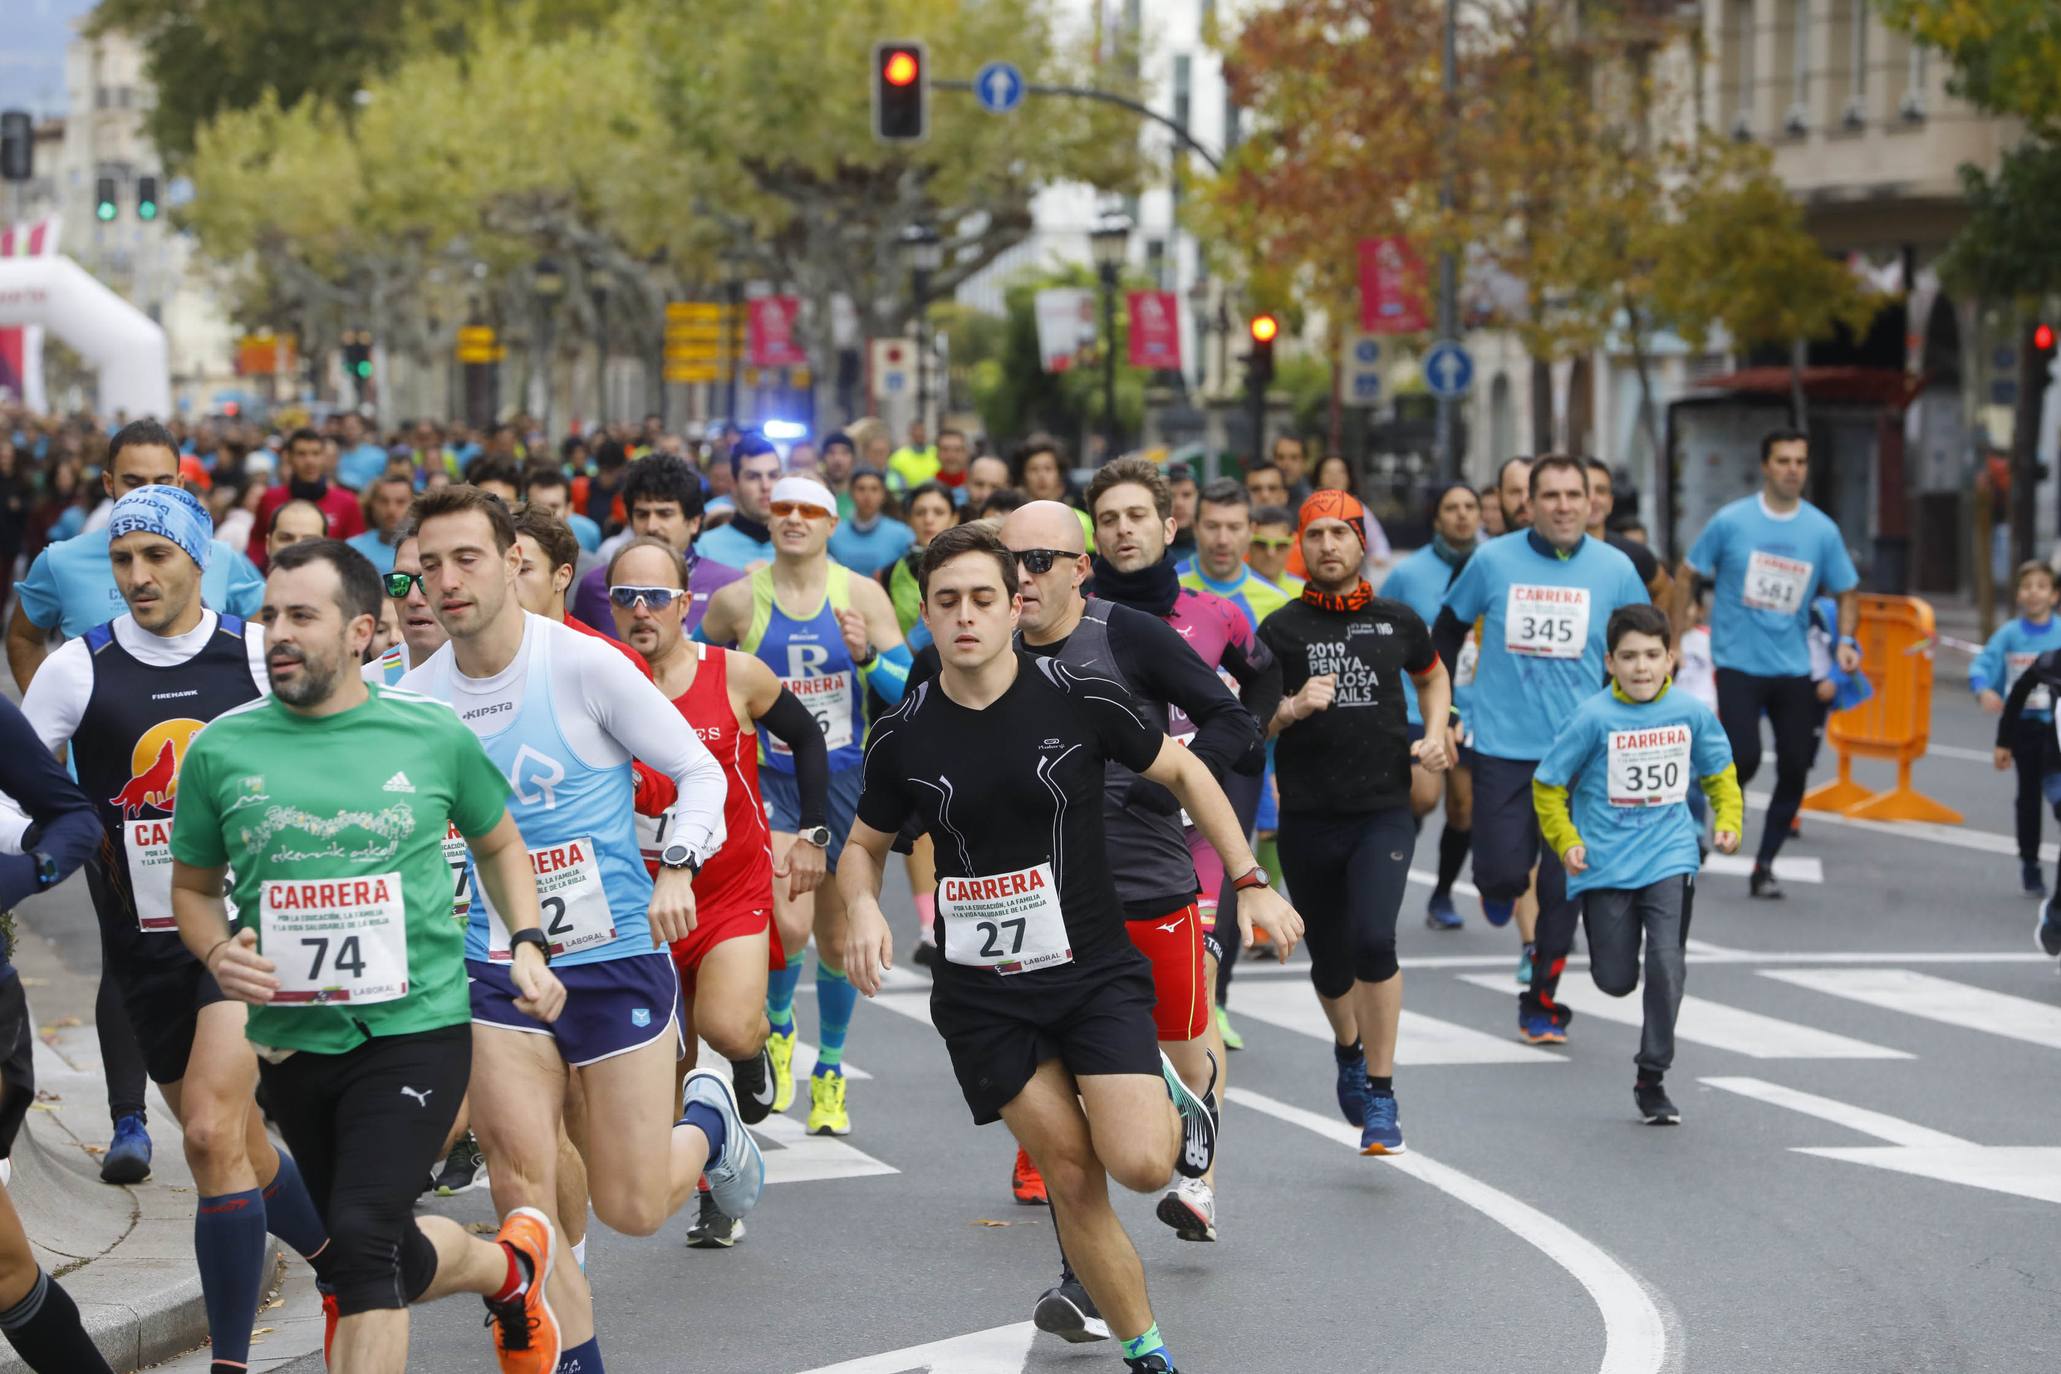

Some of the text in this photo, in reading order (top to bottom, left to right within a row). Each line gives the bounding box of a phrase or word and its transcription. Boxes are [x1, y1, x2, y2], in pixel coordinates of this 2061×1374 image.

[1515, 587, 1583, 604] CARRERA
[1521, 616, 1574, 642] 345
[1306, 641, 1346, 660] 2019
[152, 689, 198, 700] FIREHAWK
[1616, 729, 1686, 750] CARRERA
[1625, 761, 1678, 792] 350
[270, 879, 390, 910] CARRERA
[946, 869, 1046, 902] CARRERA
[1016, 893, 1041, 905] FAMILIA
[1029, 899, 1047, 910] RIOJA
[541, 896, 574, 936] 2
[566, 932, 604, 948] LABORAL
[976, 916, 1027, 958] 27
[301, 936, 367, 981] 74
[1024, 952, 1061, 966] LABORAL
[353, 984, 395, 997] LABORAL
